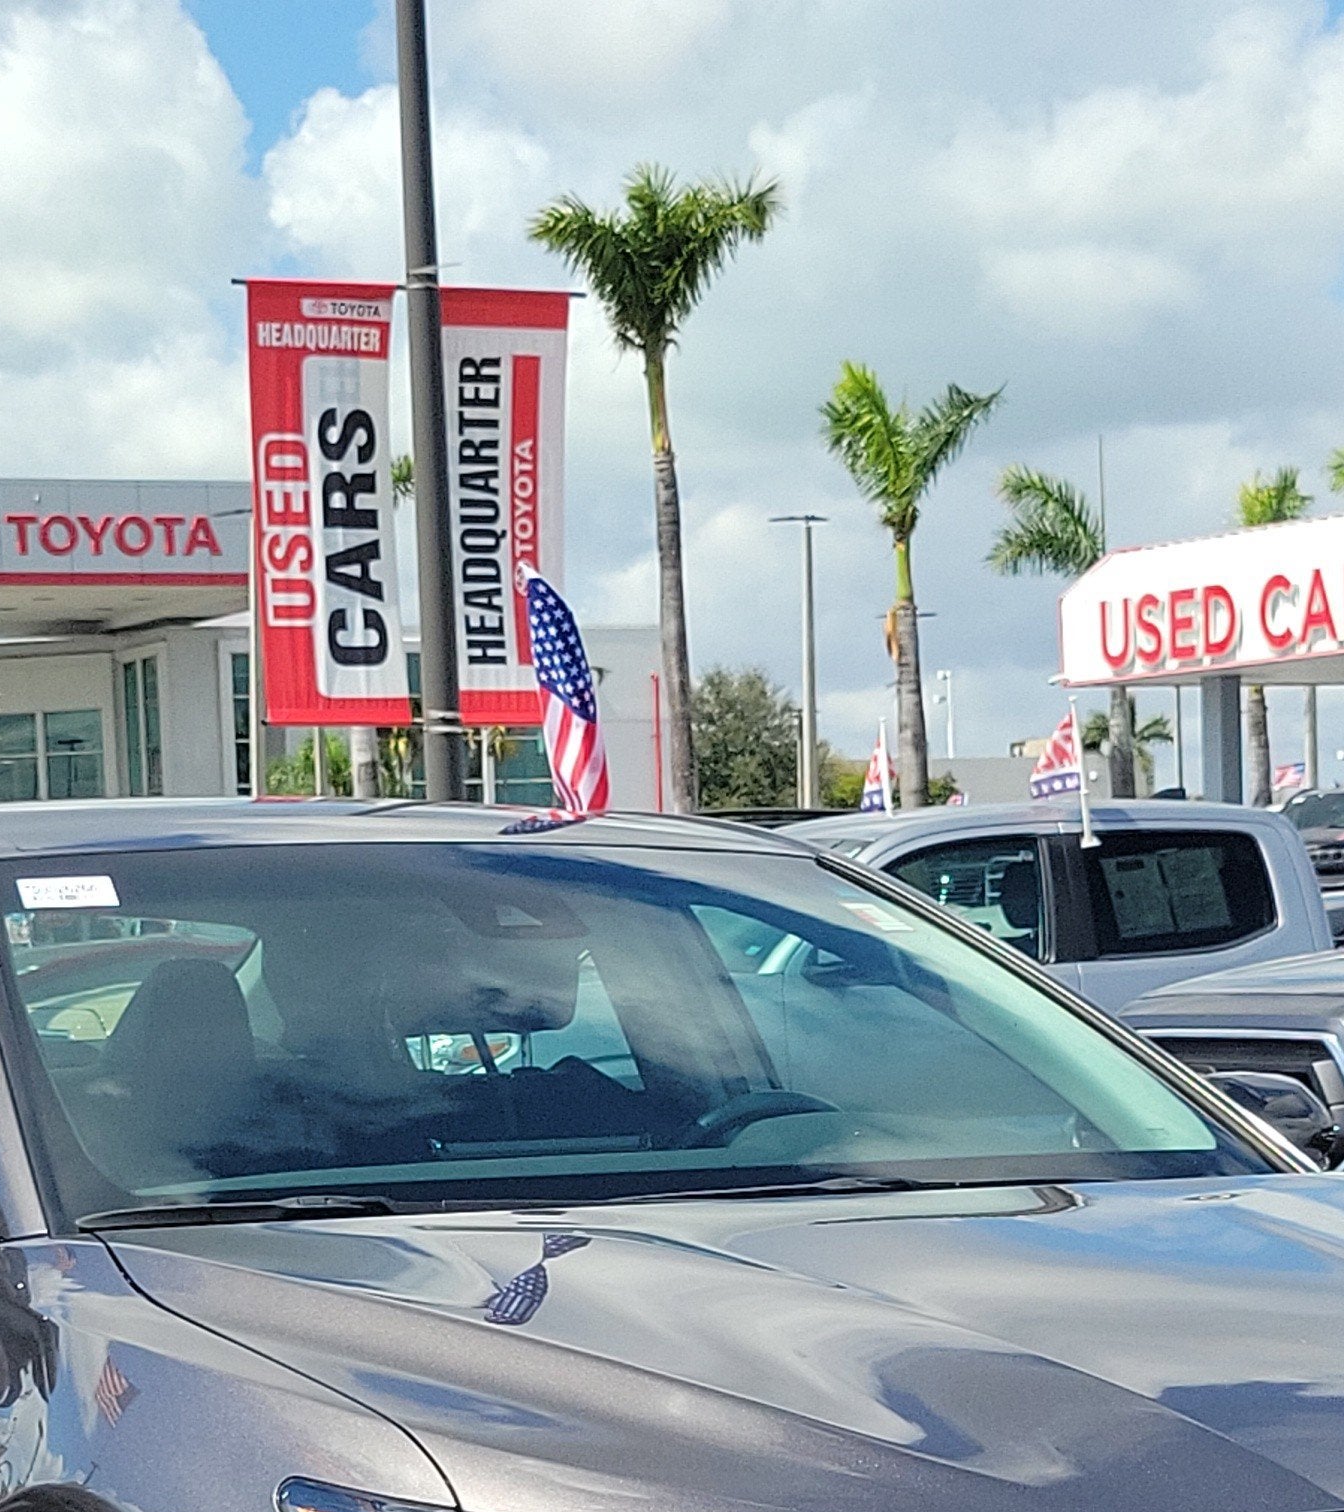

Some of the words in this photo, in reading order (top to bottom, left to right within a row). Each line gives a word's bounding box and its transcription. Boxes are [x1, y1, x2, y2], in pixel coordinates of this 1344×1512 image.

[258, 321, 381, 351] HEADQUARTER
[331, 302, 381, 317] TOYOTA
[6, 514, 223, 557] TOYOTA
[263, 437, 315, 621] USED
[318, 407, 389, 667] CARS
[457, 356, 508, 666] HEADQUARTER
[514, 439, 535, 553] TOYOTA
[1099, 584, 1237, 668] USED
